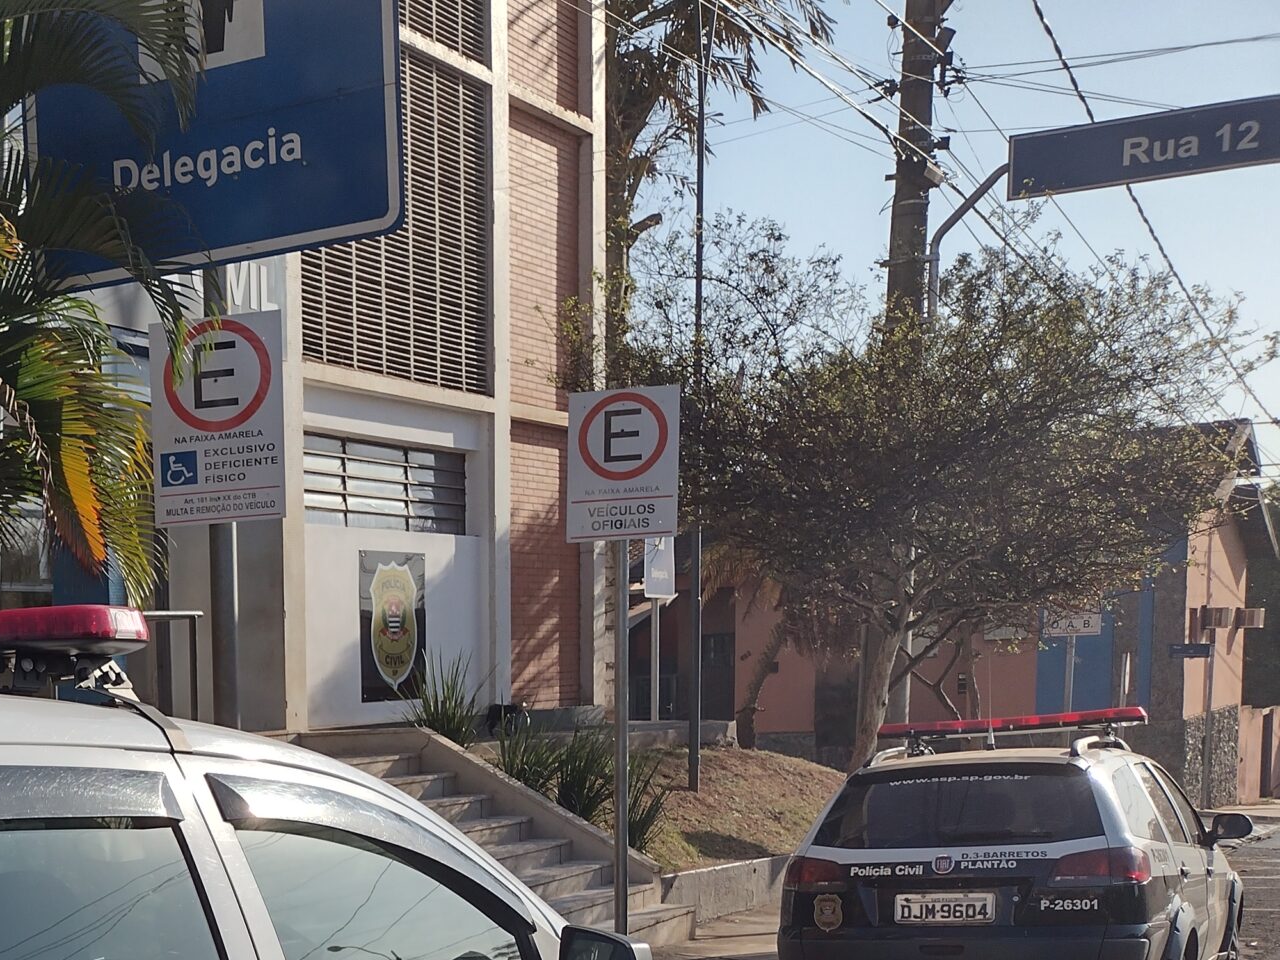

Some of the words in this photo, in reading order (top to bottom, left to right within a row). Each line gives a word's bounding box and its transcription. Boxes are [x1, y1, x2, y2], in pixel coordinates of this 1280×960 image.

[1123, 135, 1199, 167] Rua
[1215, 120, 1261, 153] 12
[113, 127, 302, 193] Delegacia
[194, 340, 239, 409] E
[174, 436, 187, 445] NA
[189, 434, 216, 443] FAIXA
[218, 429, 263, 440] AMARELA
[604, 408, 642, 463] E
[204, 442, 276, 458] EXCLUSIVO
[204, 456, 279, 471] DEFICIENTE
[205, 472, 246, 484] FÍSICO
[242, 492, 257, 500] CTB
[623, 485, 660, 494] AMARELA
[166, 507, 189, 517] MULTA
[196, 503, 231, 515] REMOÇÃO
[232, 503, 243, 511] DO
[245, 499, 276, 510] VEÍCULO
[587, 503, 655, 518] VEÍCULOS
[591, 518, 650, 531] OFICIAIS
[385, 654, 405, 668] CIVIL
[889, 774, 1032, 786] www.ssp.sp.gov.br
[961, 850, 1048, 860] D.3-BARRETOS
[850, 865, 891, 877] Polícia
[895, 864, 924, 876] Civil
[960, 858, 1017, 869] PLANTÃO
[1040, 898, 1098, 911] P-26301
